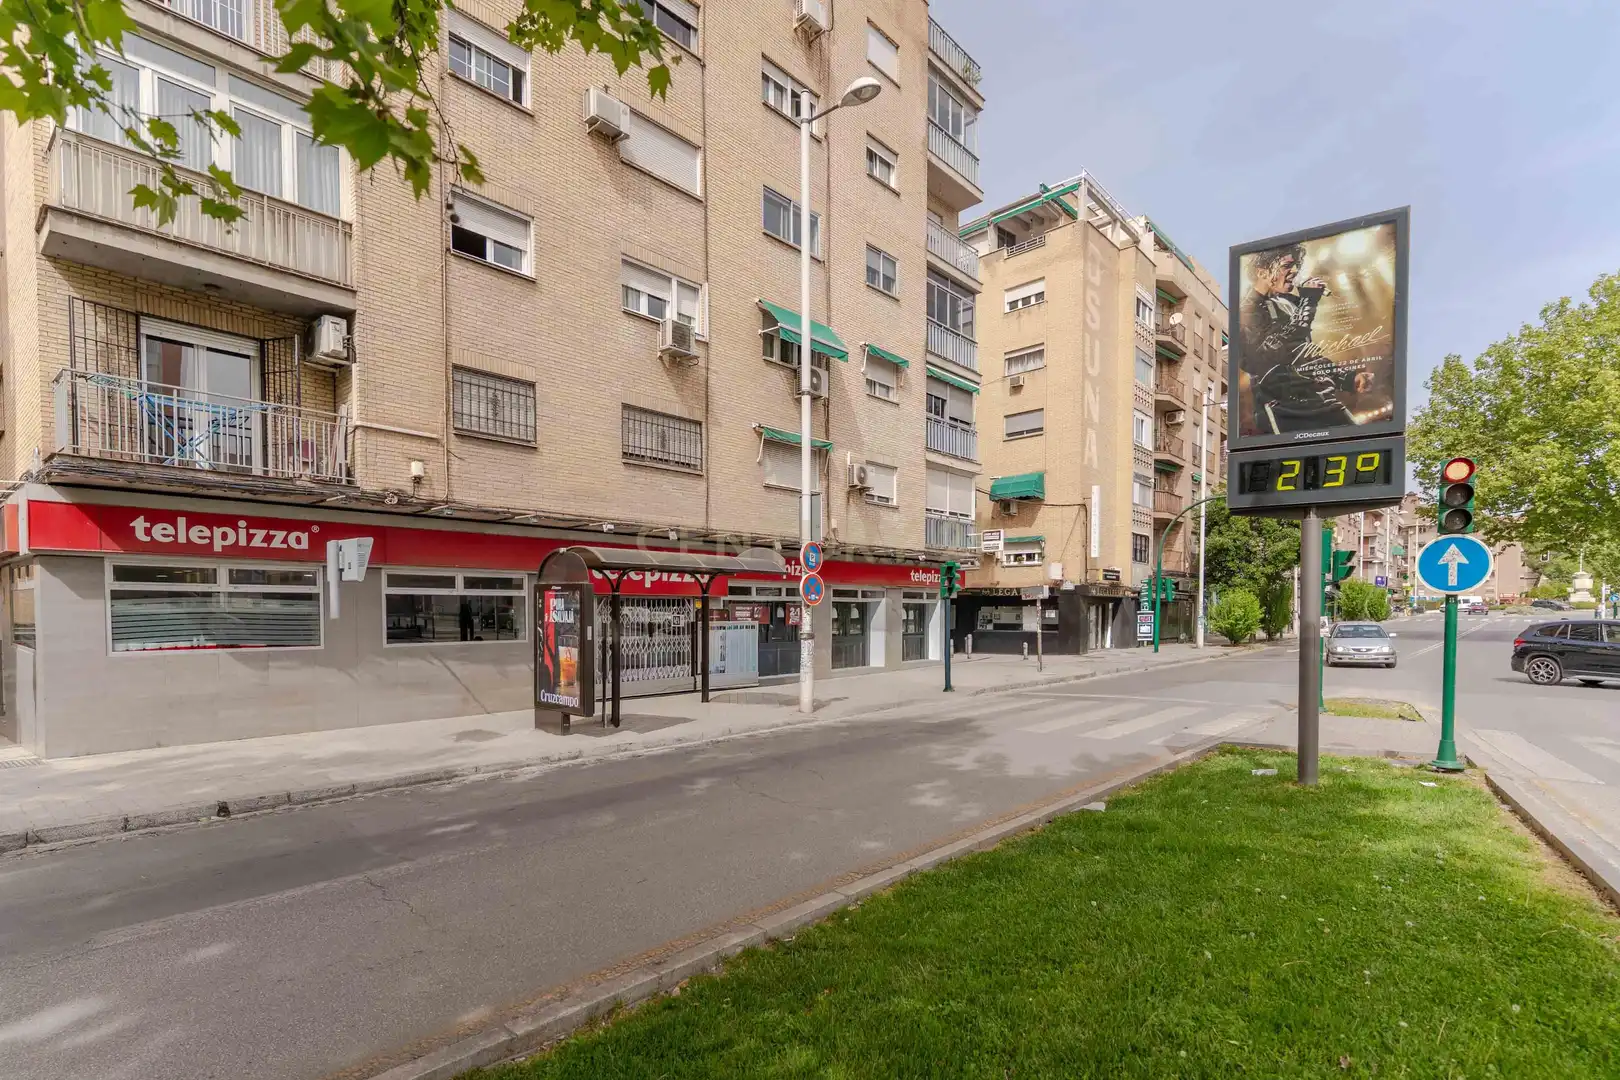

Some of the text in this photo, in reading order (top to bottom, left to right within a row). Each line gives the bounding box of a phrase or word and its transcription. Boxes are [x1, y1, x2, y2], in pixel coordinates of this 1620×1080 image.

[1292, 326, 1389, 364] Michael
[1362, 355, 1383, 363] ABRIL
[1344, 363, 1366, 372] CINES
[1294, 430, 1330, 440] JCDecaux
[540, 688, 579, 708] Cruzcampo
